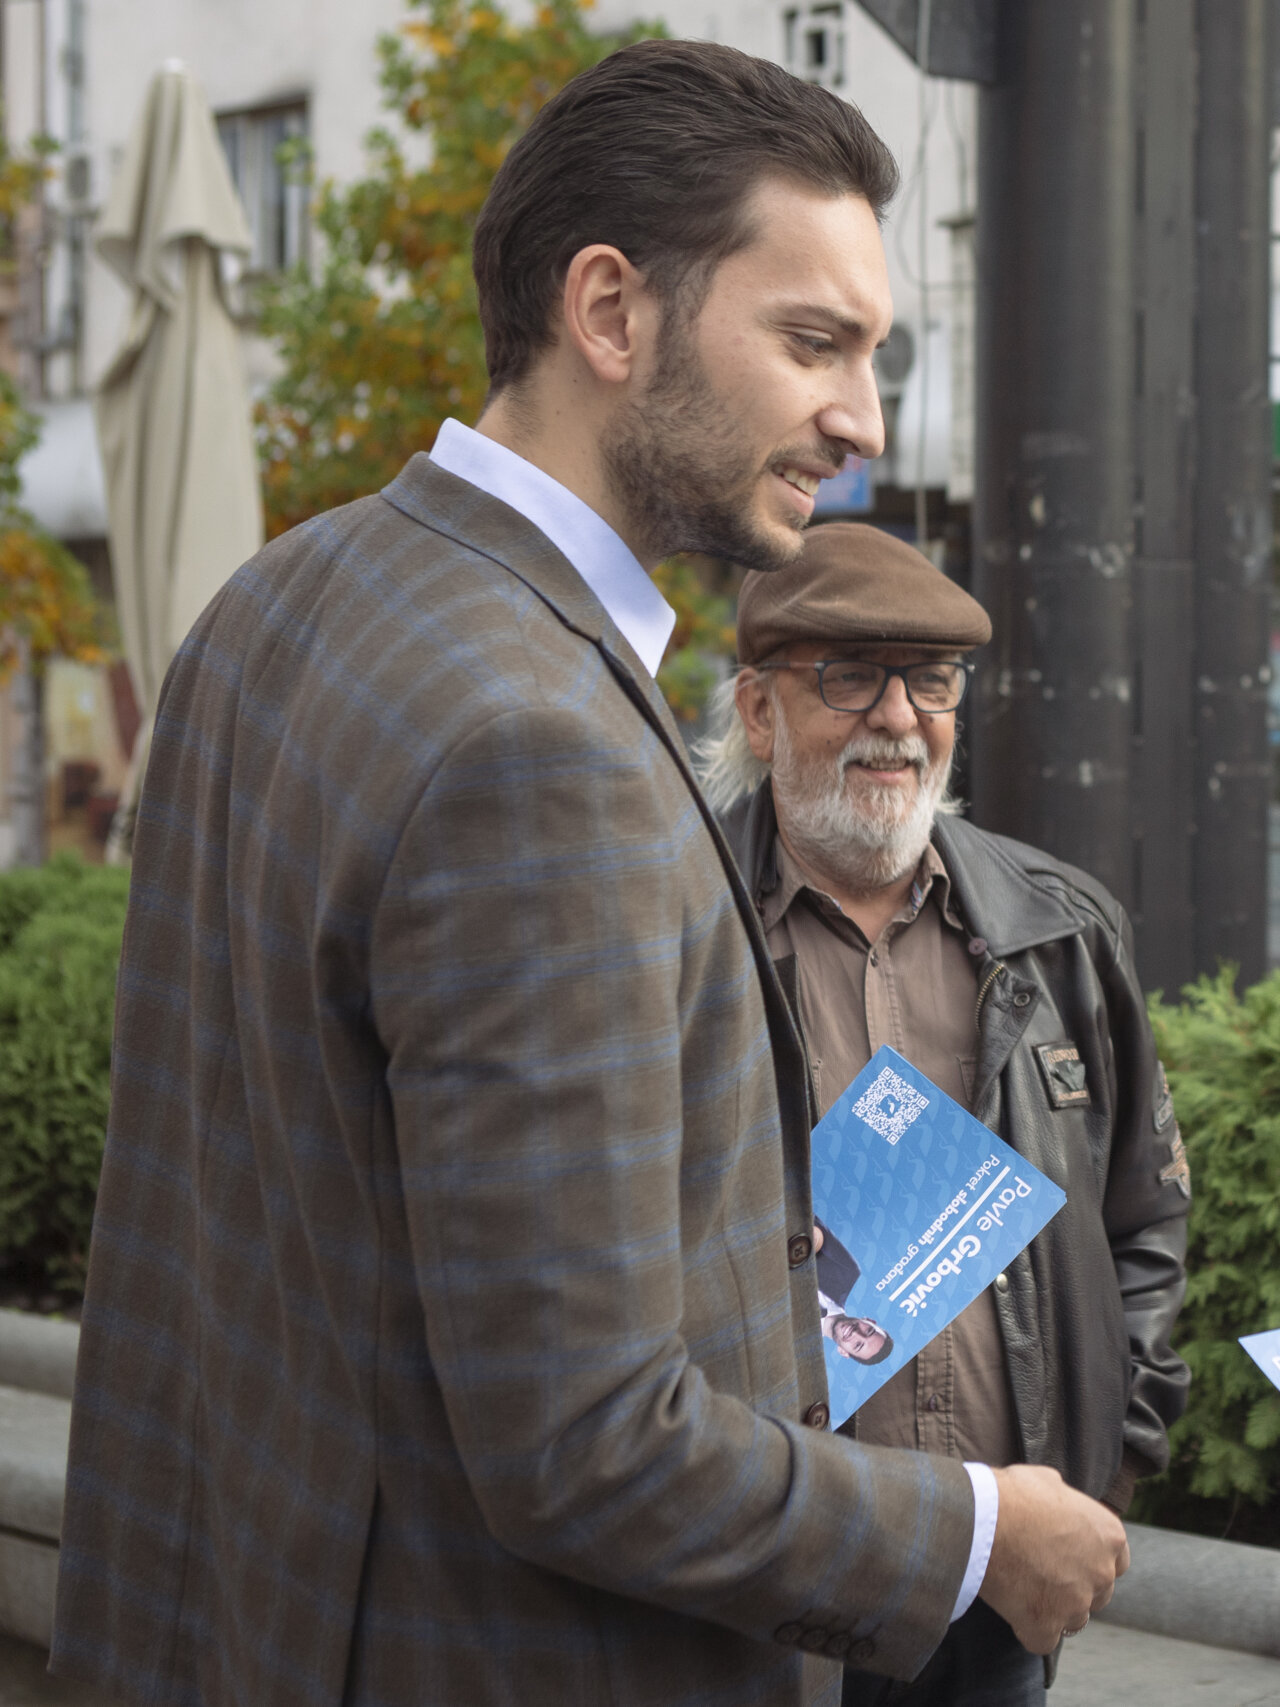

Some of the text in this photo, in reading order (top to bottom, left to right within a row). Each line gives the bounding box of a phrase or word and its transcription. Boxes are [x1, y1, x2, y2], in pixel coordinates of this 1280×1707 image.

[966, 1154, 1000, 1190] Pokret
[918, 1189, 968, 1246] slobodnih
[899, 1176, 1033, 1317] Pavle Grbović
